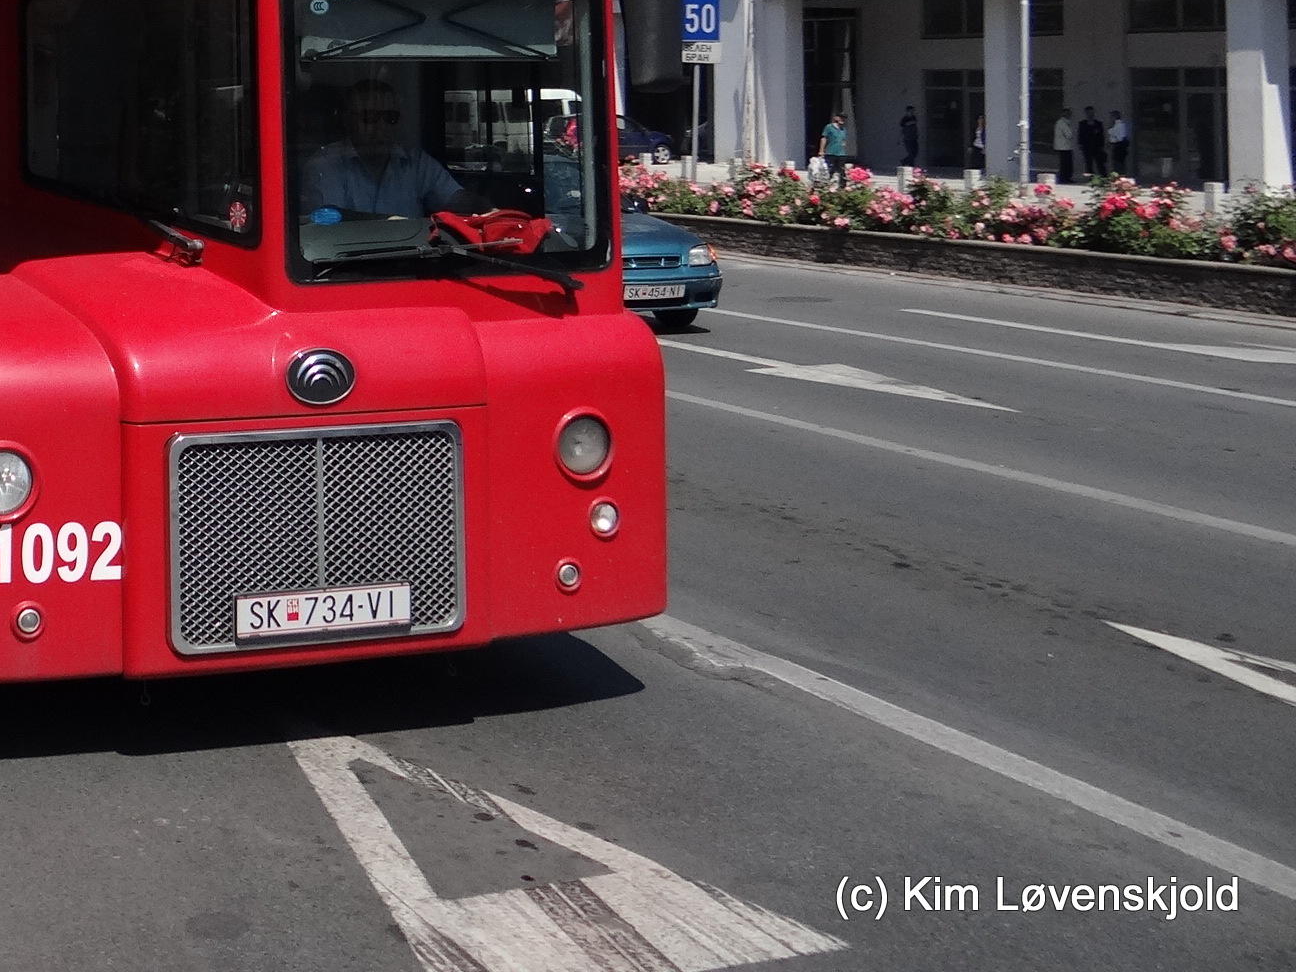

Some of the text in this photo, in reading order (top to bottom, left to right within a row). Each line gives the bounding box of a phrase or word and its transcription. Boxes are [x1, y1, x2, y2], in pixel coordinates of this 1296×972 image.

[685, 3, 716, 34] 50
[627, 288, 641, 299] SK
[249, 590, 394, 630] SK 734-VI
